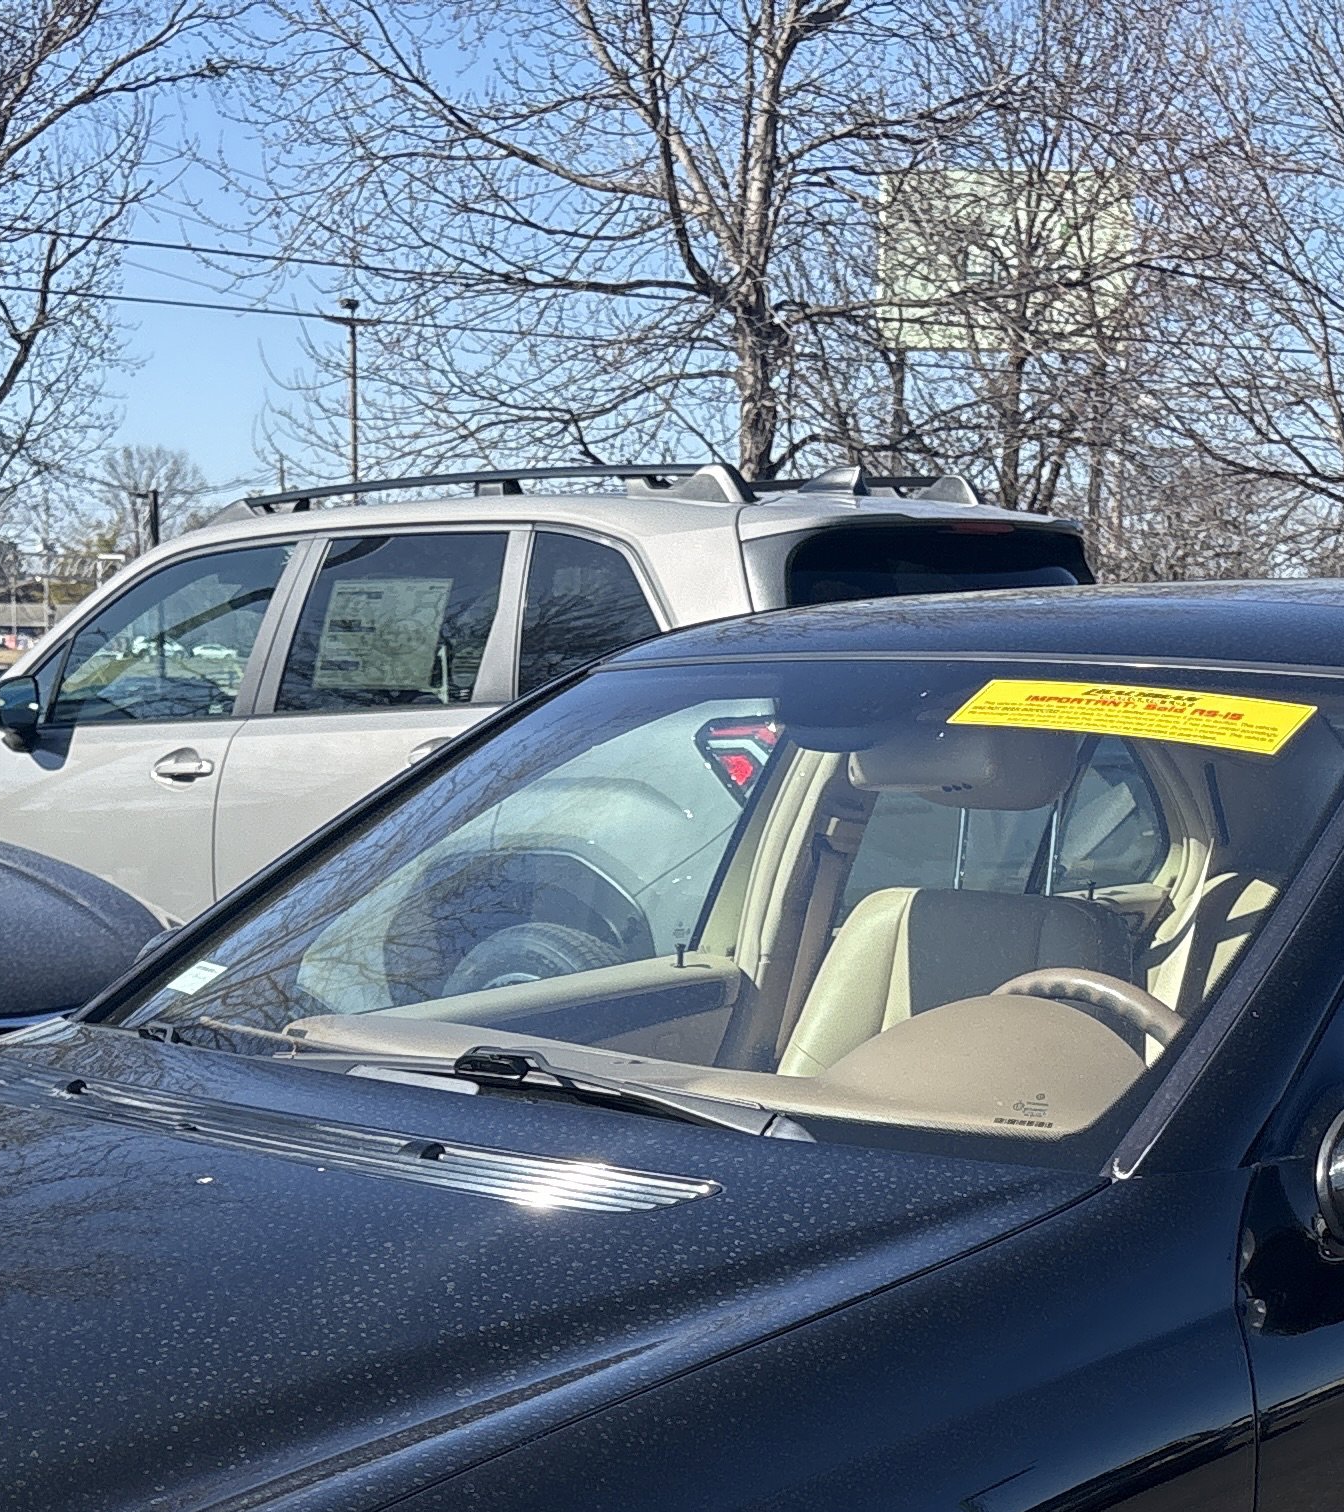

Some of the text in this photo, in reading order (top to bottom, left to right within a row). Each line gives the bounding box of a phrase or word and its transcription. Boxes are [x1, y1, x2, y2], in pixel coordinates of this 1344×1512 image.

[1025, 694, 1137, 709] IMPORTANT:
[1144, 703, 1187, 714] Sold
[1190, 708, 1244, 721] AS-IS
